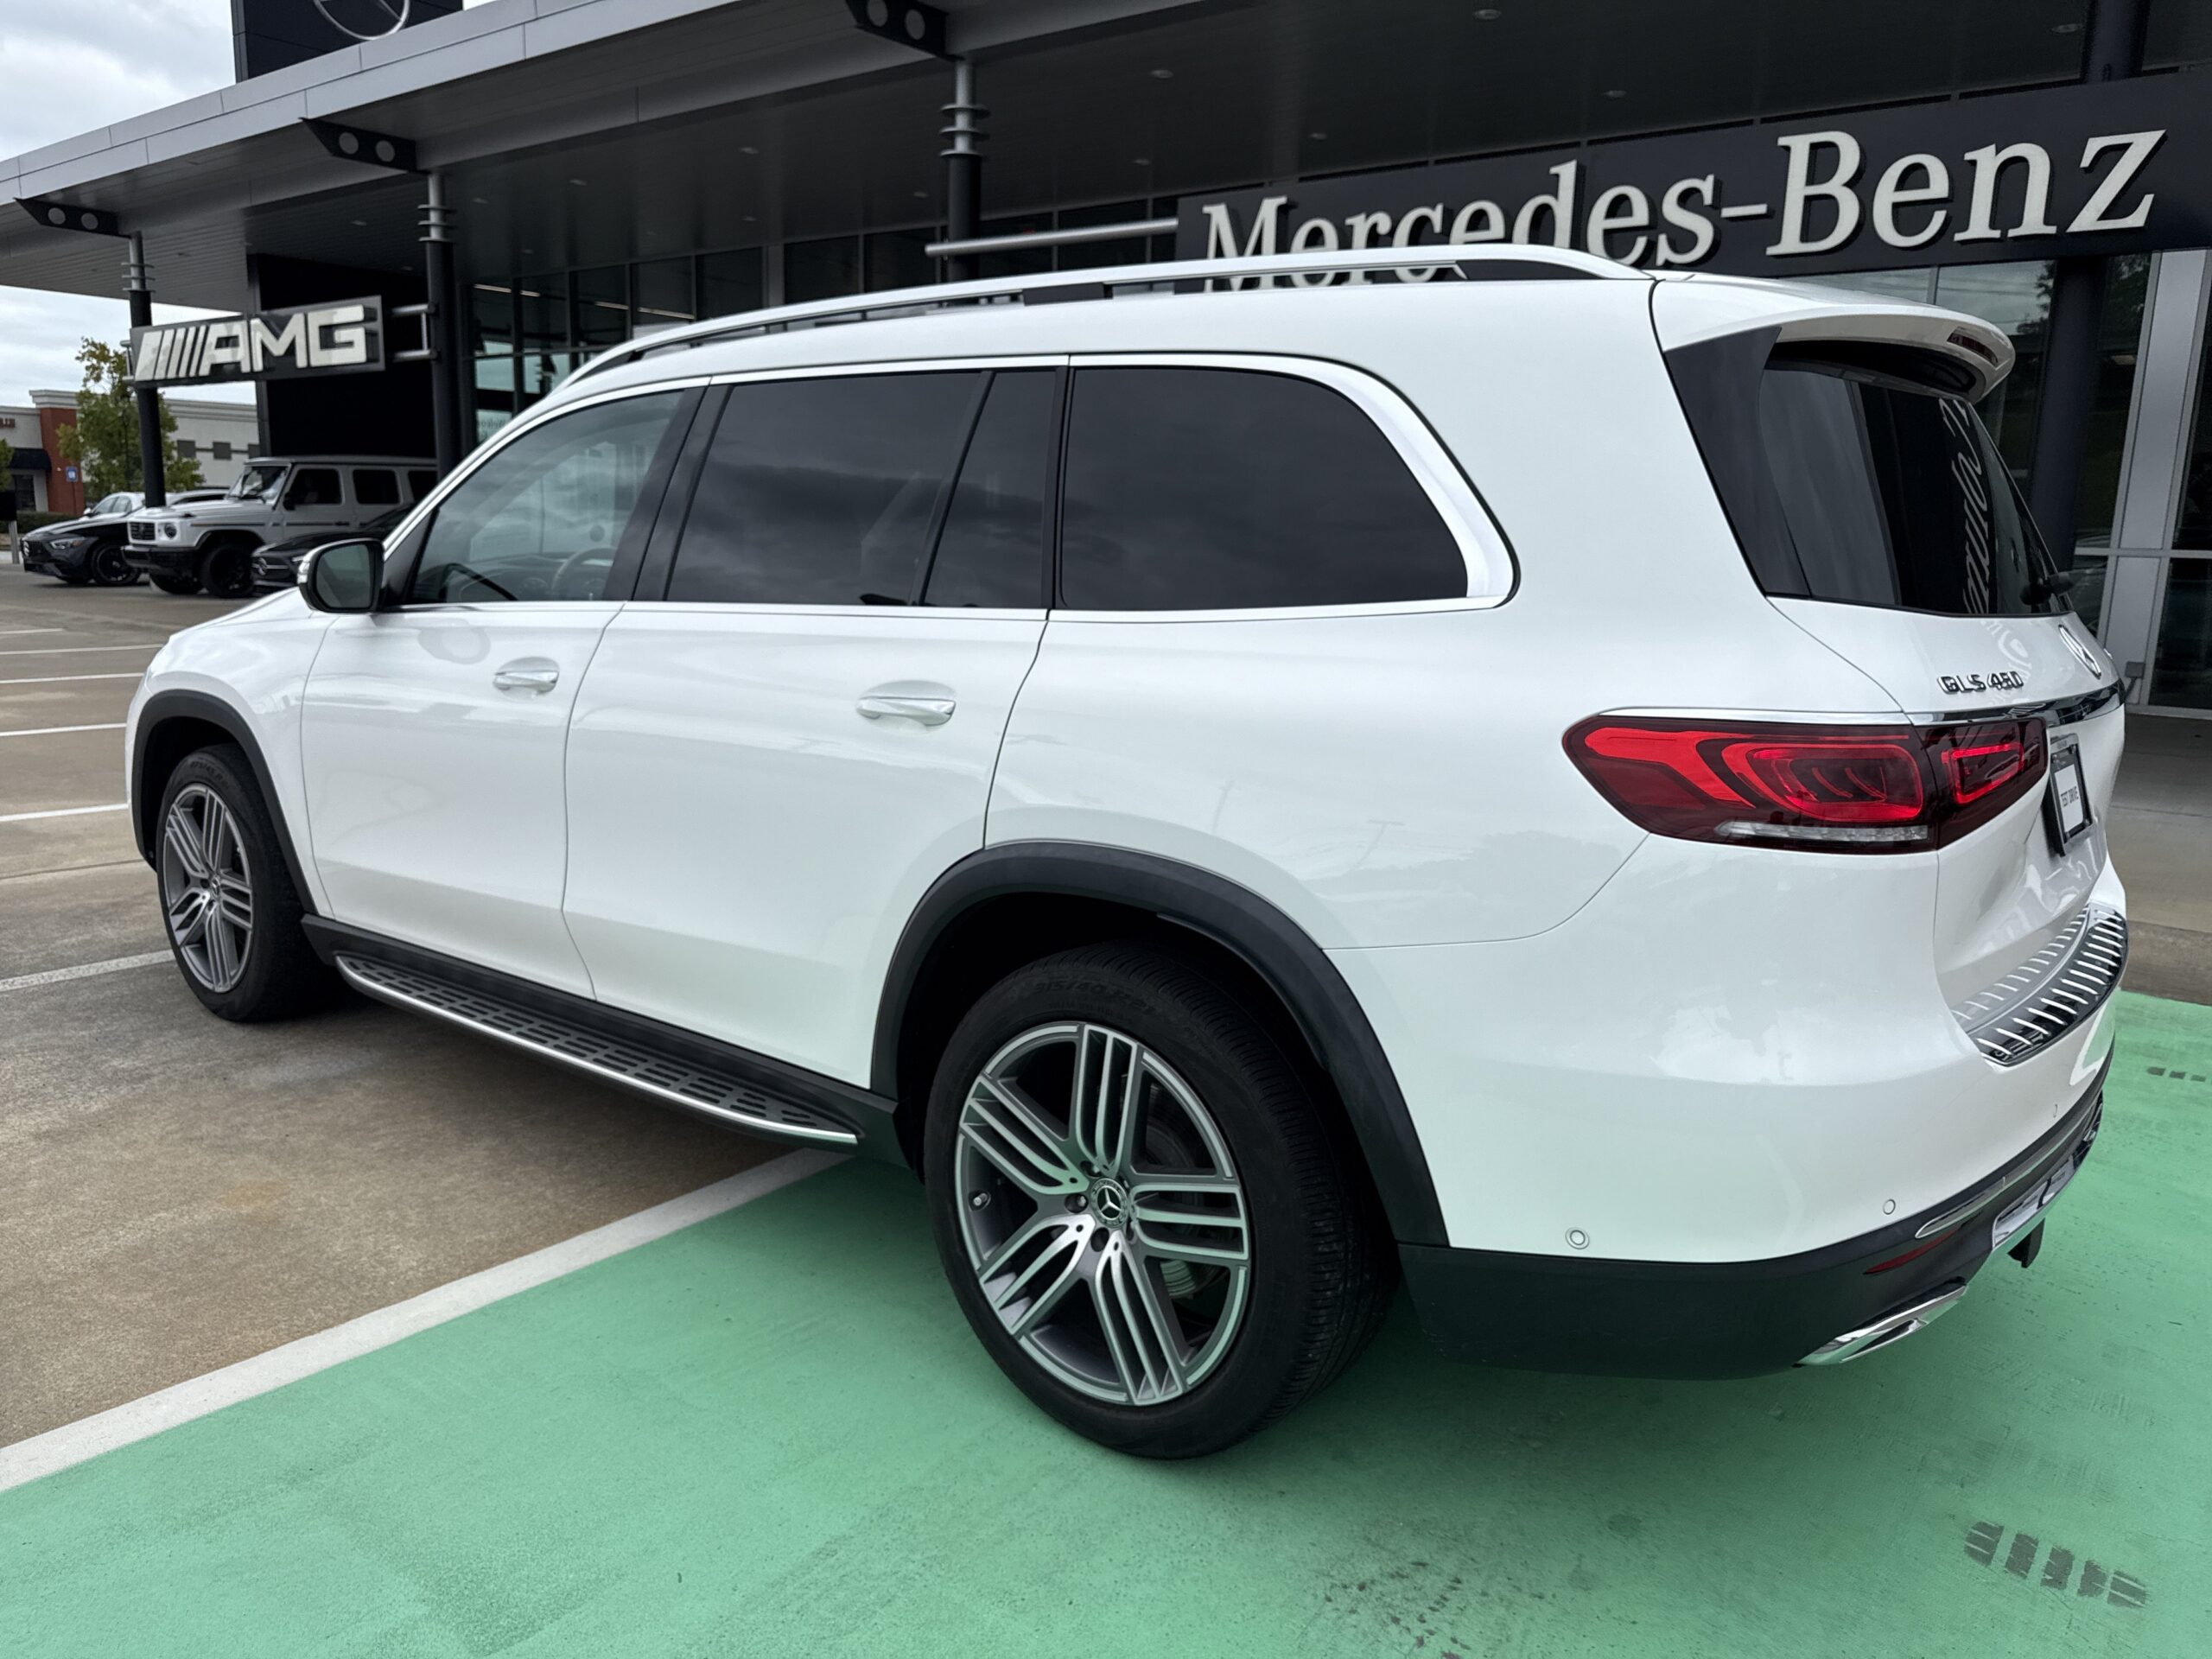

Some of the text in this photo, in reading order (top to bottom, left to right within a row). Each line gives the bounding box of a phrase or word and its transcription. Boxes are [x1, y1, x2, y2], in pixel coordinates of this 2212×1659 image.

[1201, 130, 2167, 292] Mercedes-Benz
[1937, 671, 2024, 695] GLS 450
